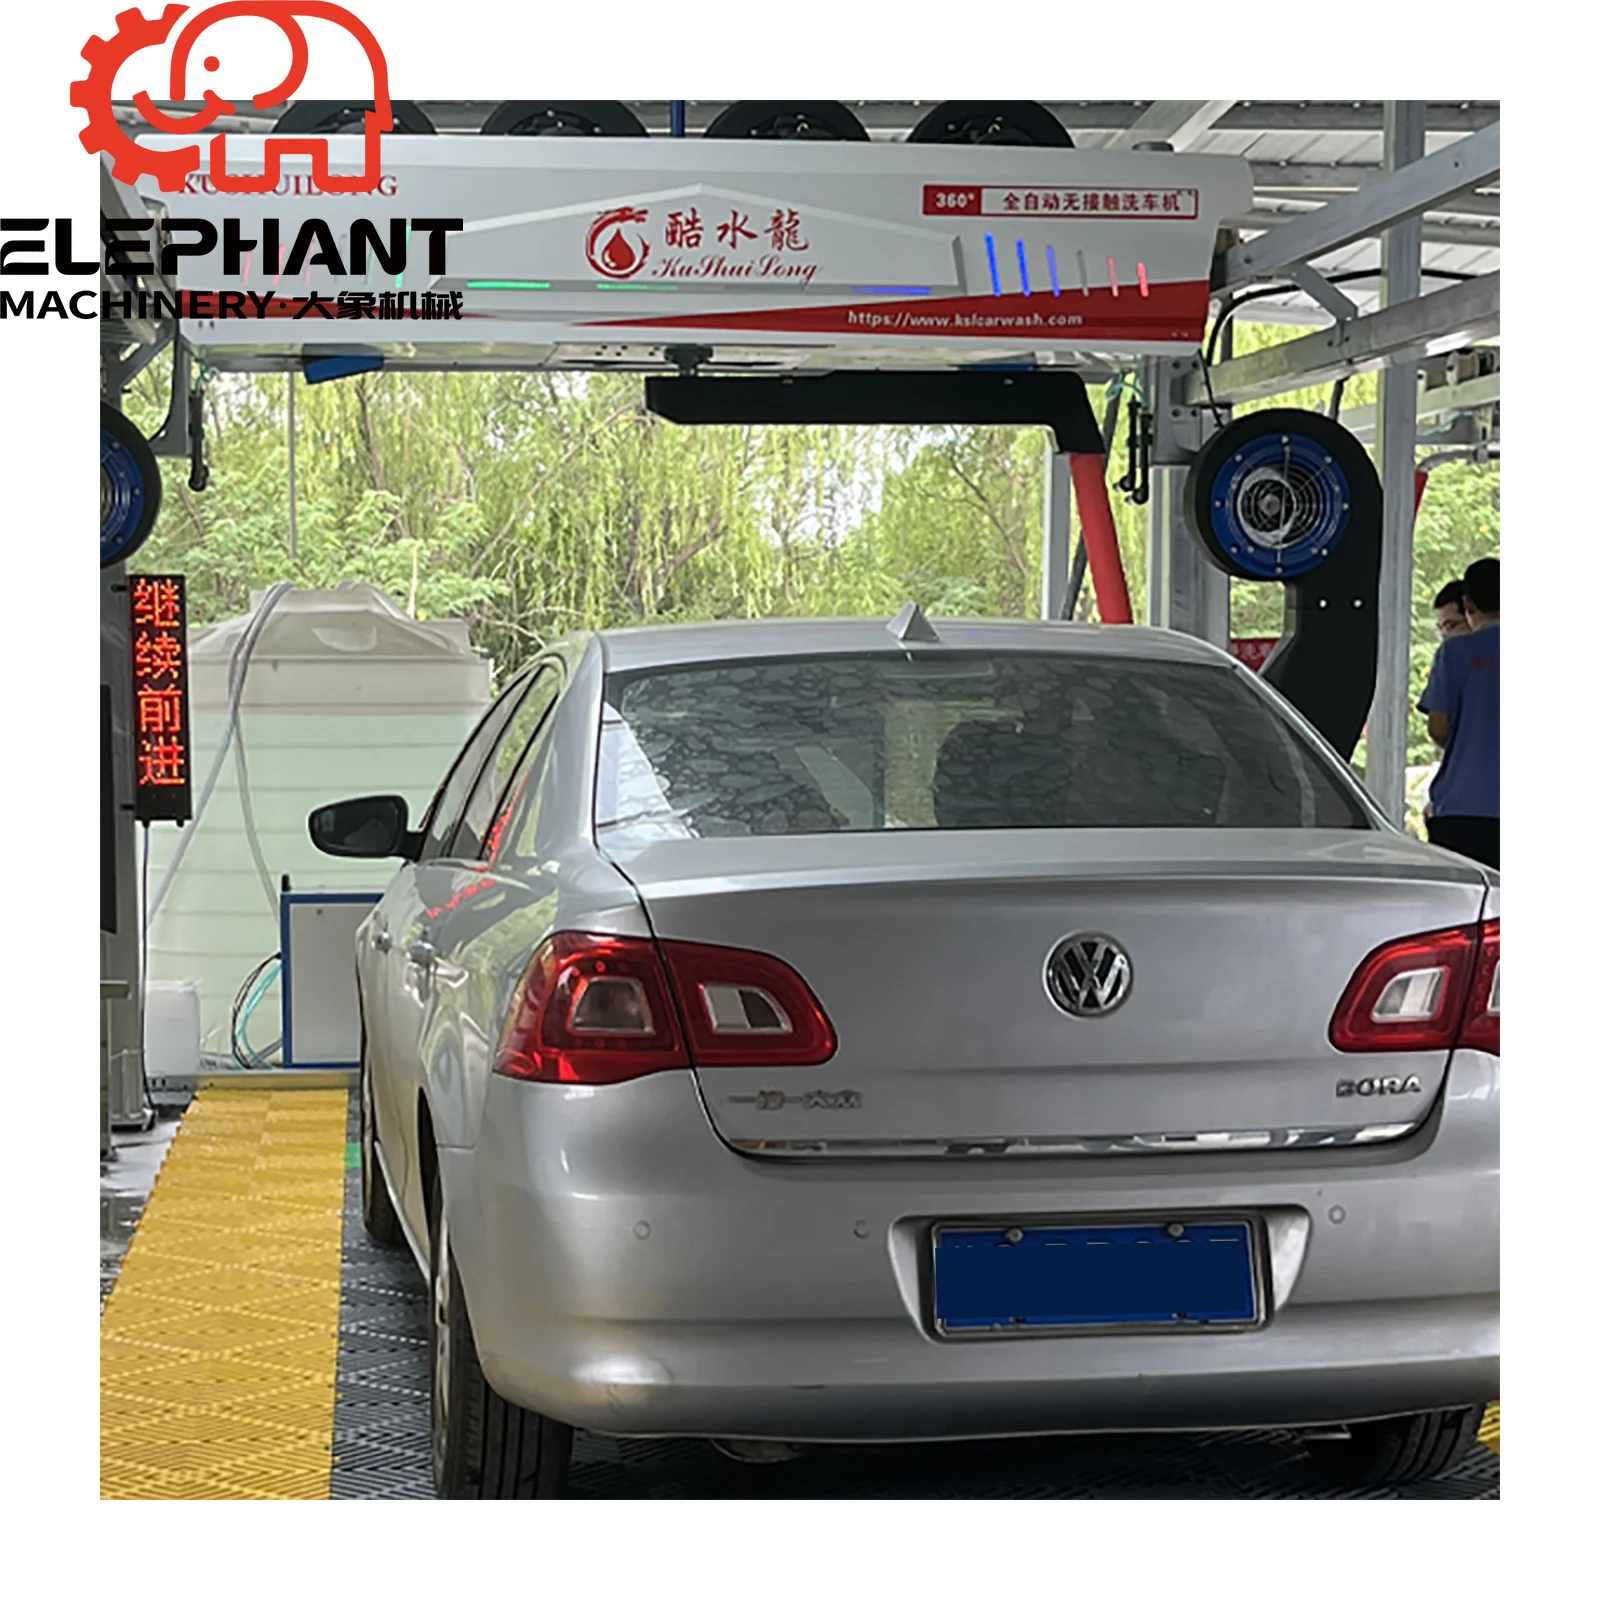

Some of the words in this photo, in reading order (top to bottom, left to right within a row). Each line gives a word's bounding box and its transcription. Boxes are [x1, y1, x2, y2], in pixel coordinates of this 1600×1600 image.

[1003, 192, 1181, 212] 全自动无接触洗车机
[665, 207, 809, 252] 酷水龍
[134, 578, 185, 786] 继续前进
